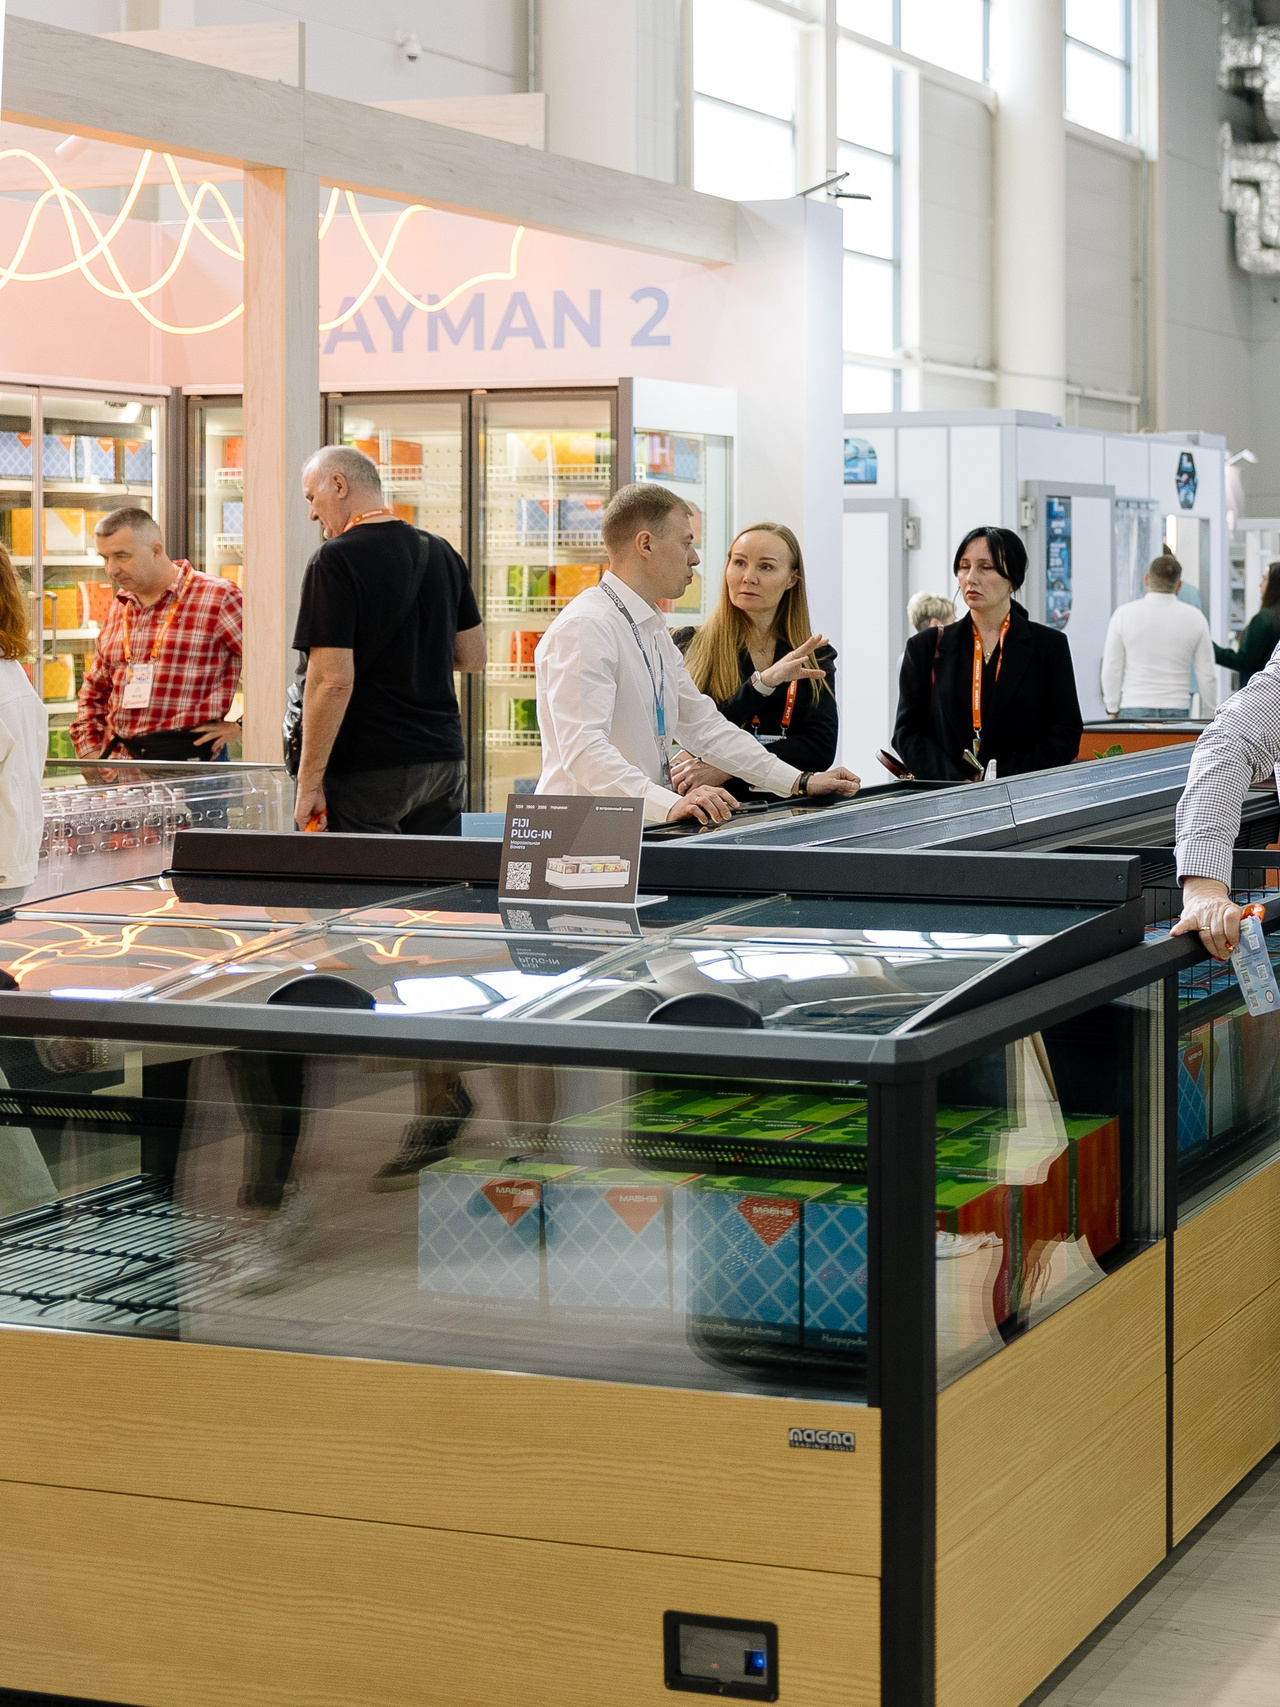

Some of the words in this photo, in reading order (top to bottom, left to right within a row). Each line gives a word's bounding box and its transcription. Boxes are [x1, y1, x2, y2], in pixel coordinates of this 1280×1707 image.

[319, 289, 602, 355] AYMAN
[630, 286, 671, 347] 2
[512, 817, 530, 828] FIJI
[511, 828, 552, 840] PLUG-IN
